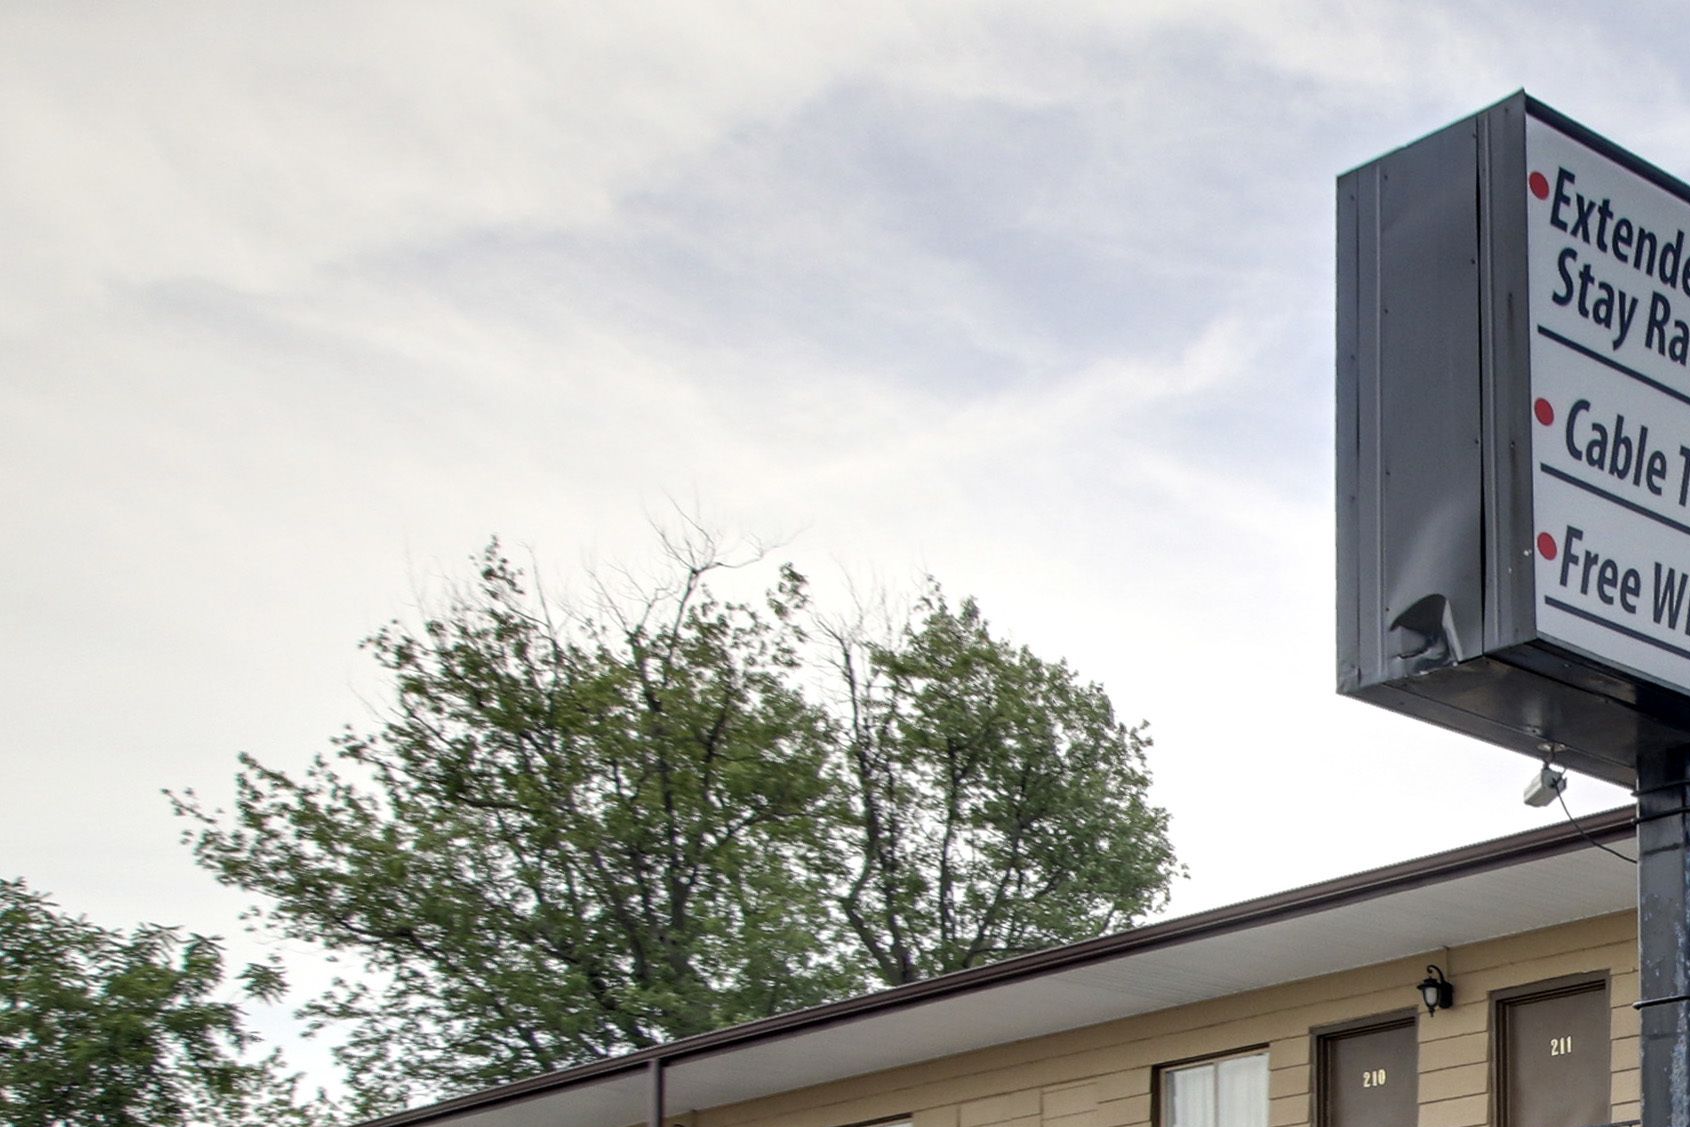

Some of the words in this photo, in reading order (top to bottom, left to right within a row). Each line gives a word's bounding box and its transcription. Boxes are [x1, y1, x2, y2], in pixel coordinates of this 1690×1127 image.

[1551, 247, 1637, 350] Stay
[1564, 399, 1667, 497] Cable
[1560, 525, 1641, 613] Free
[1362, 1068, 1387, 1088] 210
[1550, 1035, 1572, 1056] 211
